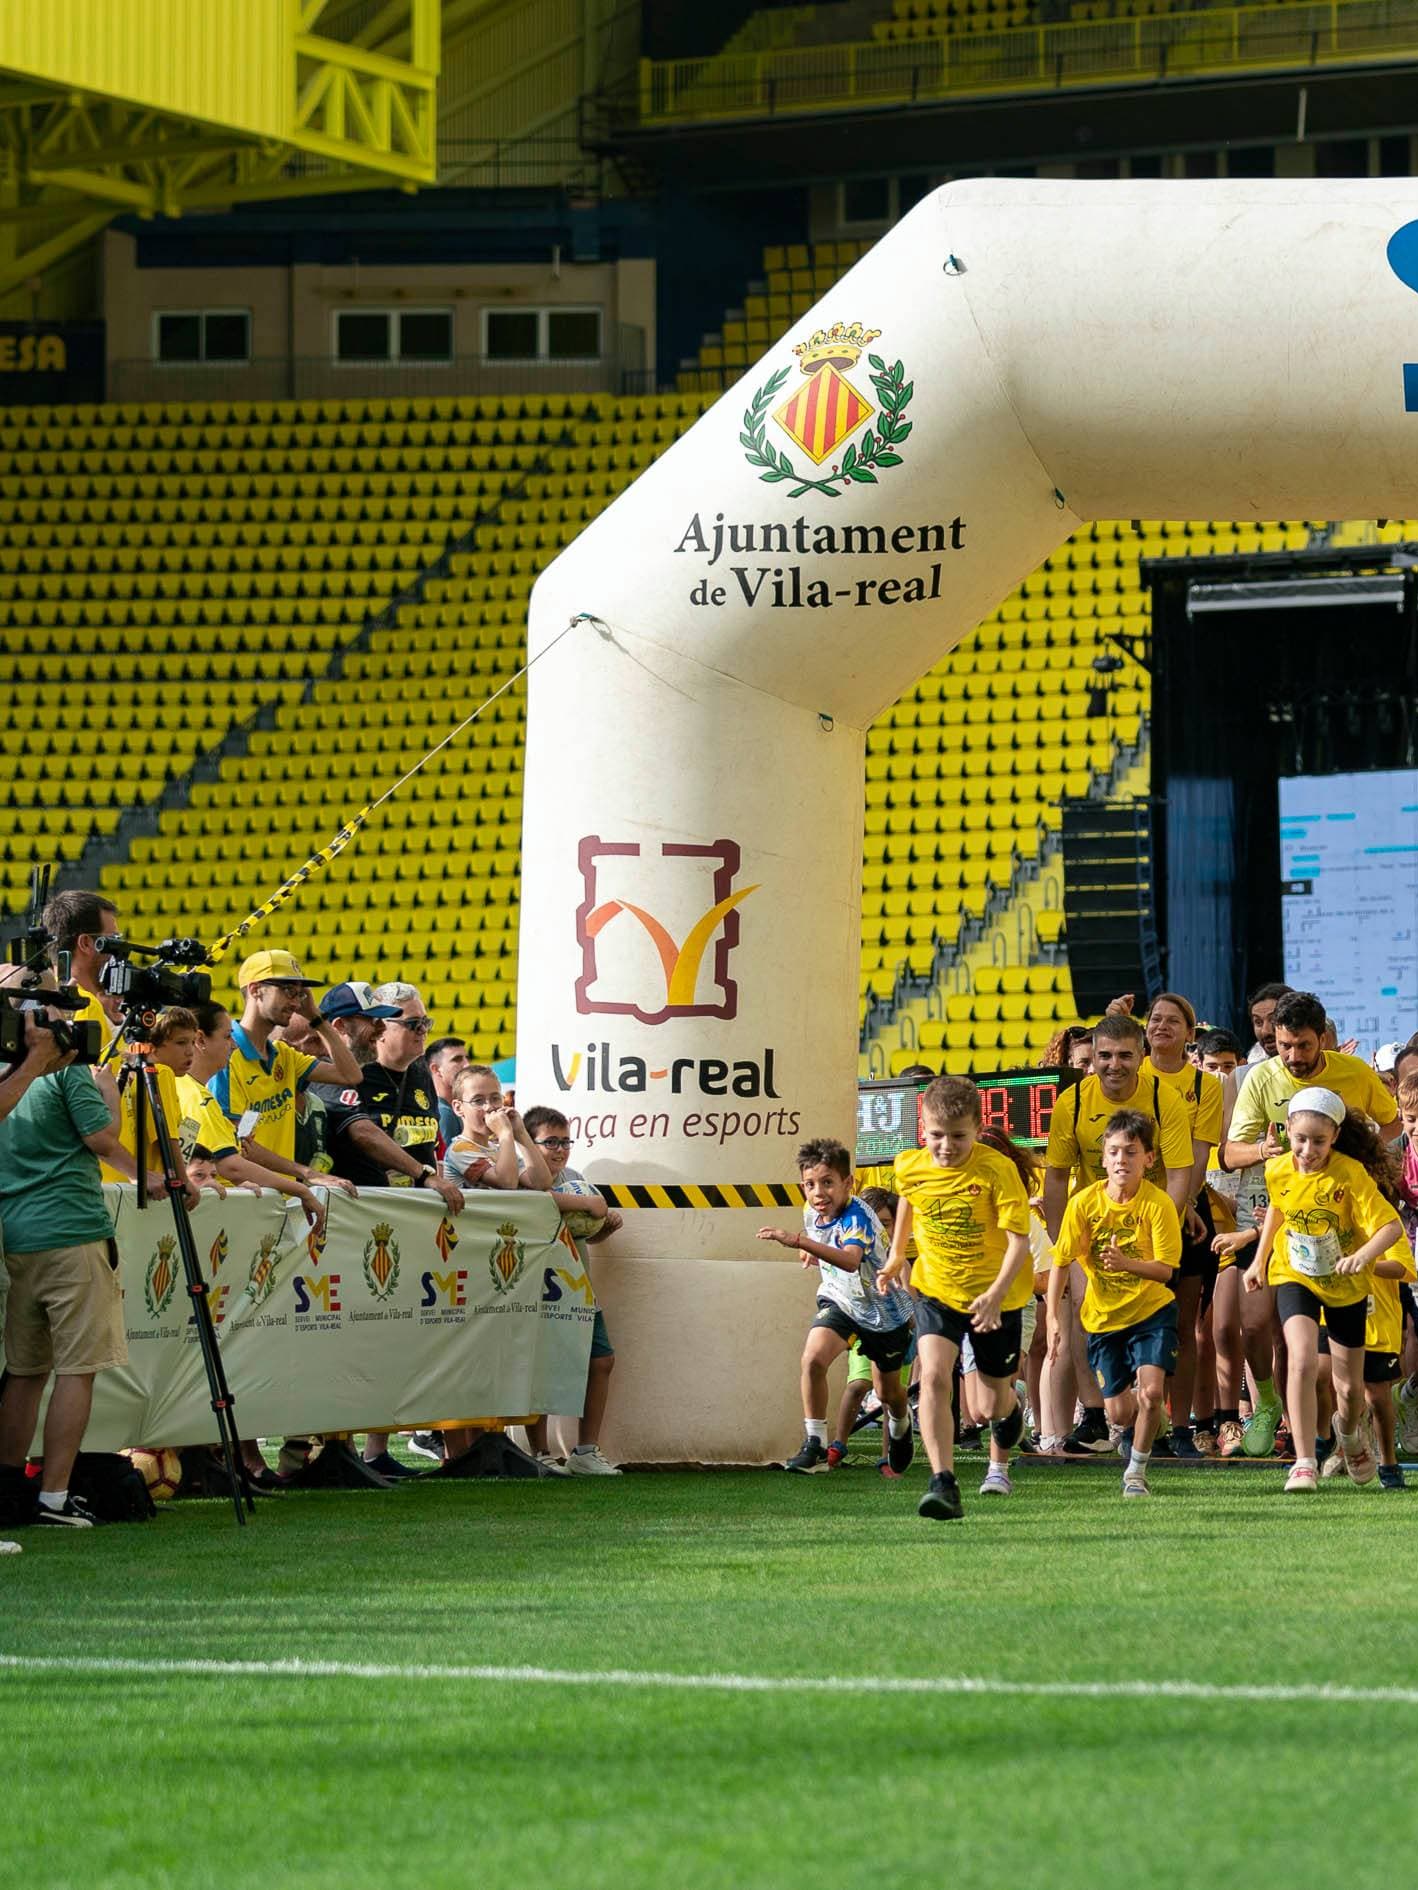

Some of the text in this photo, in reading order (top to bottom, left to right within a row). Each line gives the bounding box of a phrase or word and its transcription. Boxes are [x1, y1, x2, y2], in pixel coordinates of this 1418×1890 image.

[673, 512, 967, 566] Ajuntament
[689, 562, 942, 608] de Vila-real
[551, 1041, 782, 1099] Vila-real
[380, 1113, 439, 1132] PMESA
[567, 1107, 801, 1148] nça en esports
[293, 1274, 342, 1313] SME
[421, 1270, 469, 1307] SME
[542, 1267, 594, 1307] SM
[570, 1306, 596, 1315] MUNIC
